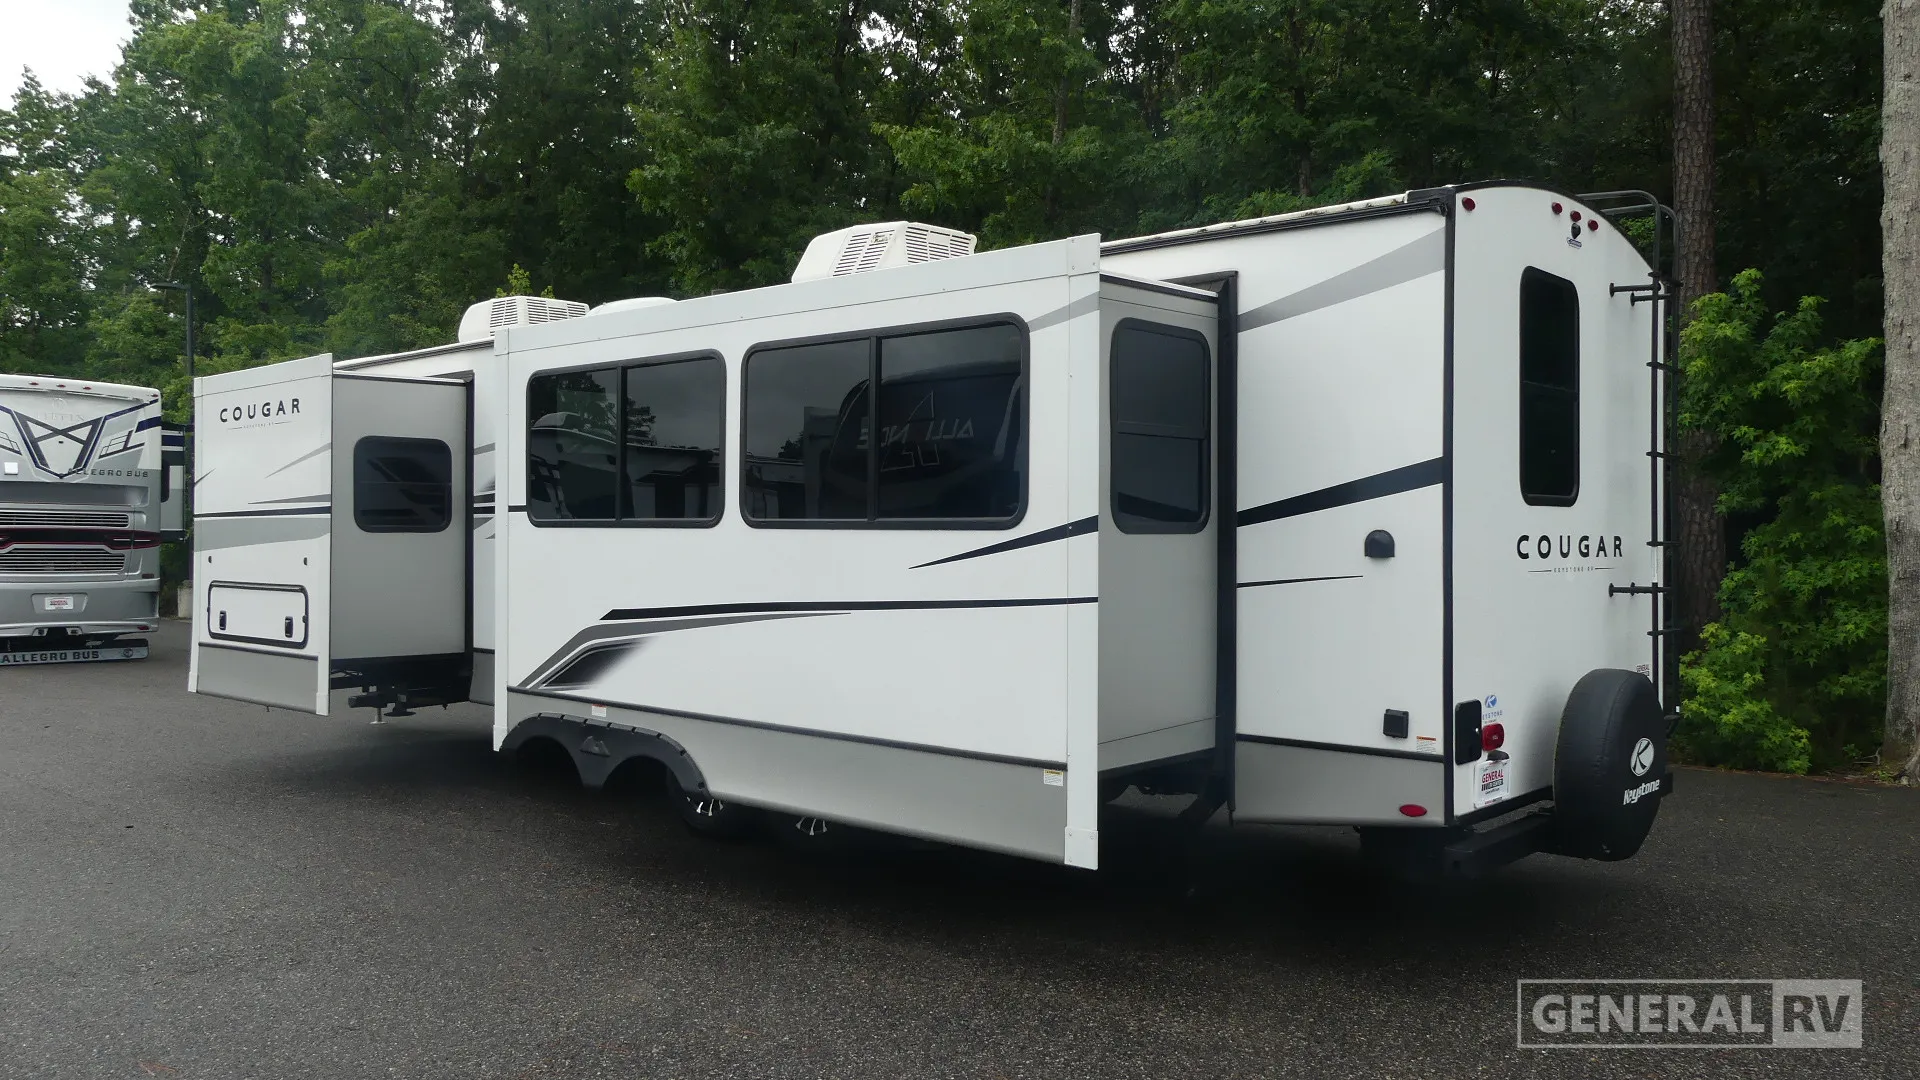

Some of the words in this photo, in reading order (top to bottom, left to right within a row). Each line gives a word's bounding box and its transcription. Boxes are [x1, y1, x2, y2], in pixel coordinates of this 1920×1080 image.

[220, 398, 300, 422] COUGAR
[127, 470, 149, 478] BUS
[1516, 534, 1623, 559] COUGAR
[1, 652, 67, 663] ALLEGRO
[73, 650, 100, 659] BUS
[1481, 769, 1504, 783] GENERAL
[1623, 779, 1660, 805] Keystone
